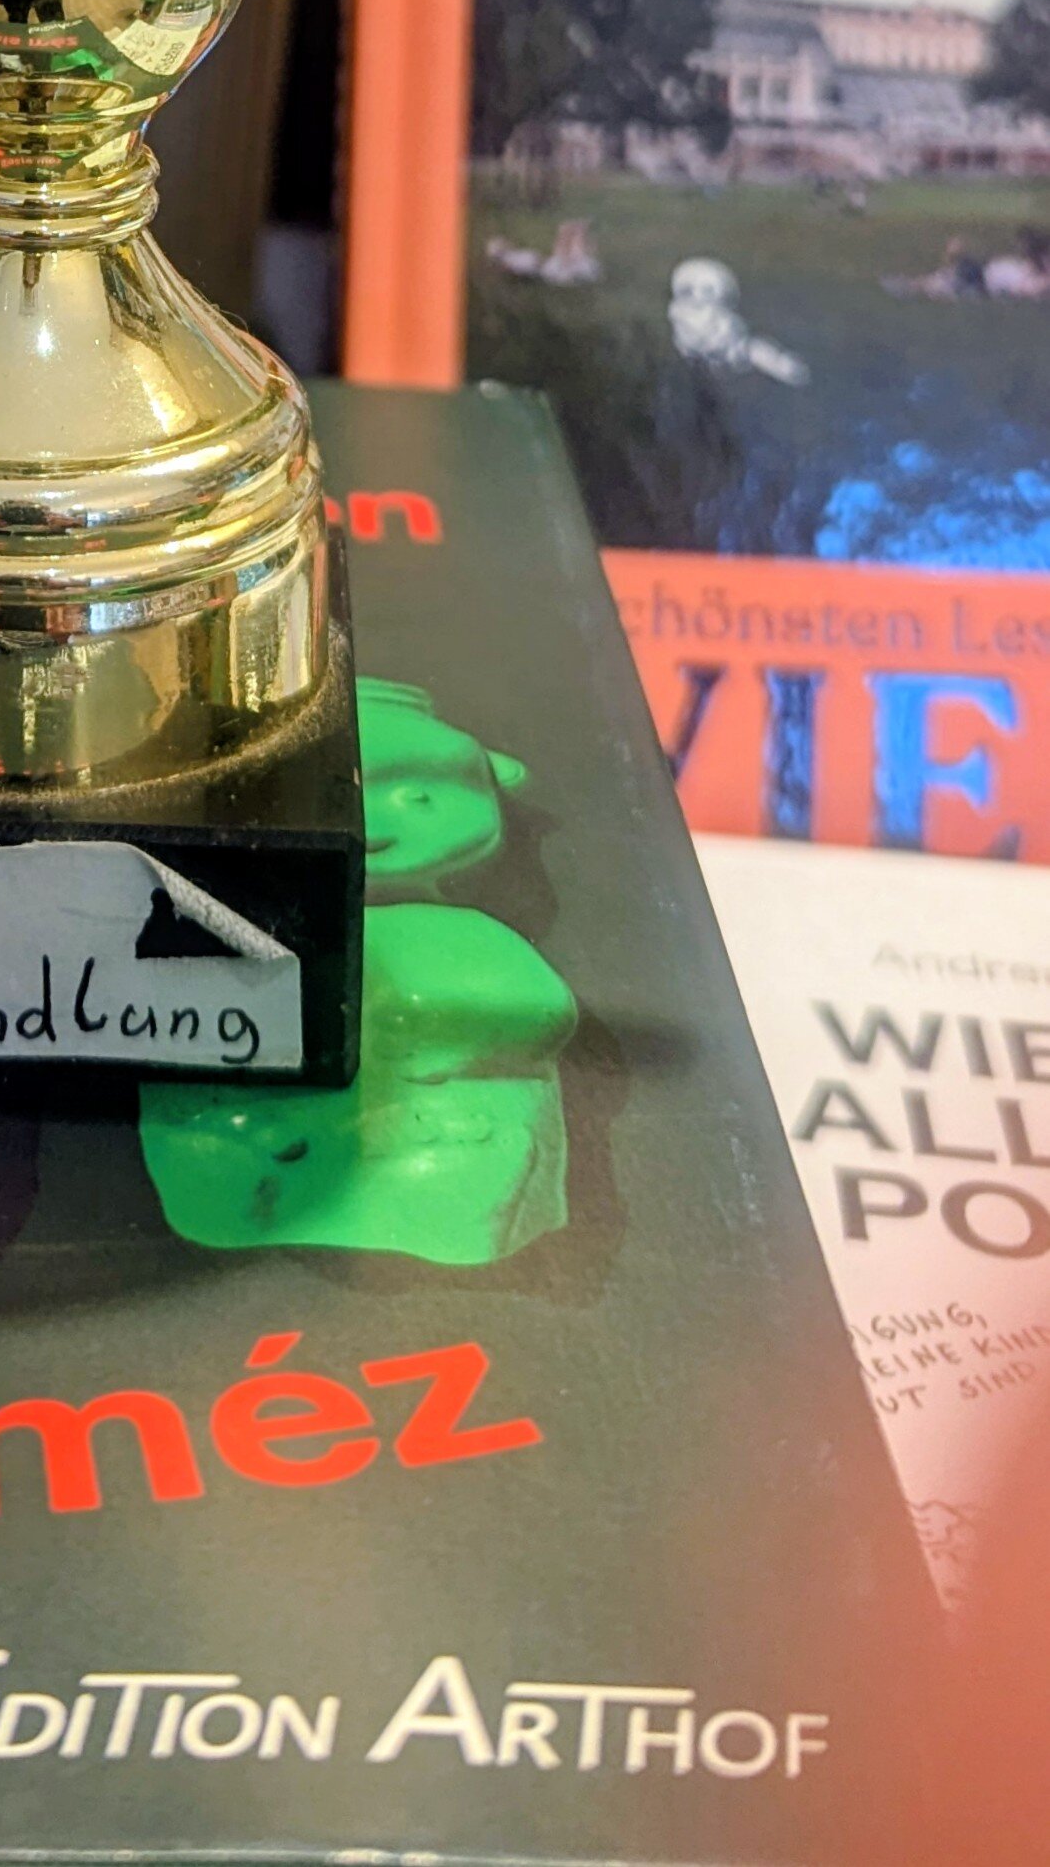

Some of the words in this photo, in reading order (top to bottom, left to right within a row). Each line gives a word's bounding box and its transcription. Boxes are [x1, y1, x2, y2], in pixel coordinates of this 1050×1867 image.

[808, 997, 1050, 1083] WIE
[792, 1075, 1050, 1169] ALL
[834, 1163, 1050, 1261] PO
[861, 1341, 962, 1383] EINE
[957, 1359, 1039, 1401] SIND
